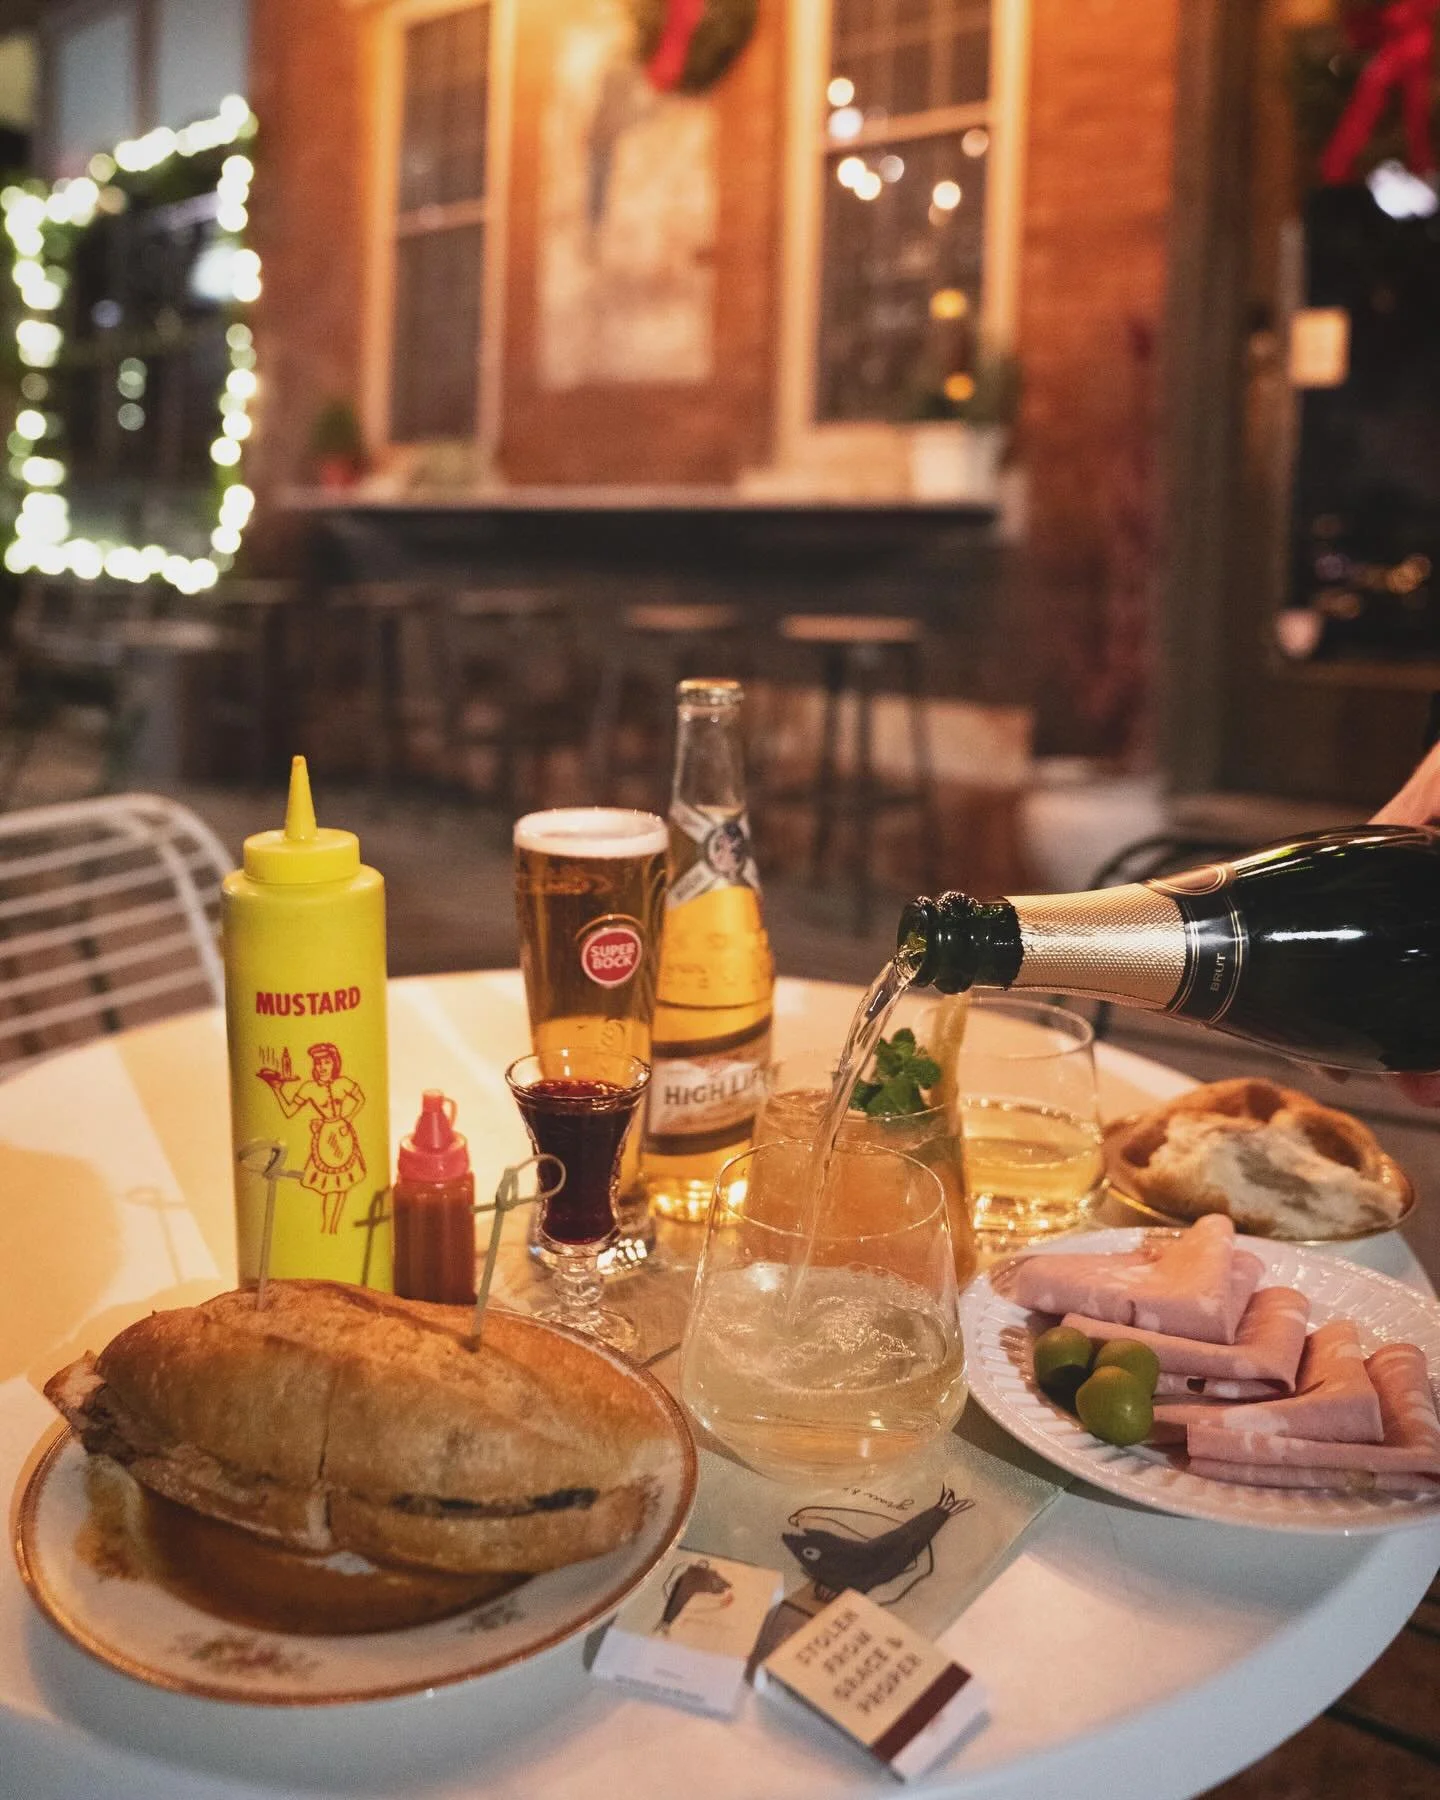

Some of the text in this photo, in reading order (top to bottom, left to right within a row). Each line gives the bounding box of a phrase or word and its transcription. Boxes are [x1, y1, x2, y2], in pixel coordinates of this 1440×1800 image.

[591, 942, 635, 957] SUPER
[592, 955, 633, 970] BOCK
[1210, 952, 1226, 992] BRUT
[256, 986, 361, 1017] MUSTARD
[664, 1078, 725, 1105] HIGH
[796, 1609, 860, 1665] STOLEN
[823, 1631, 872, 1676] FROM
